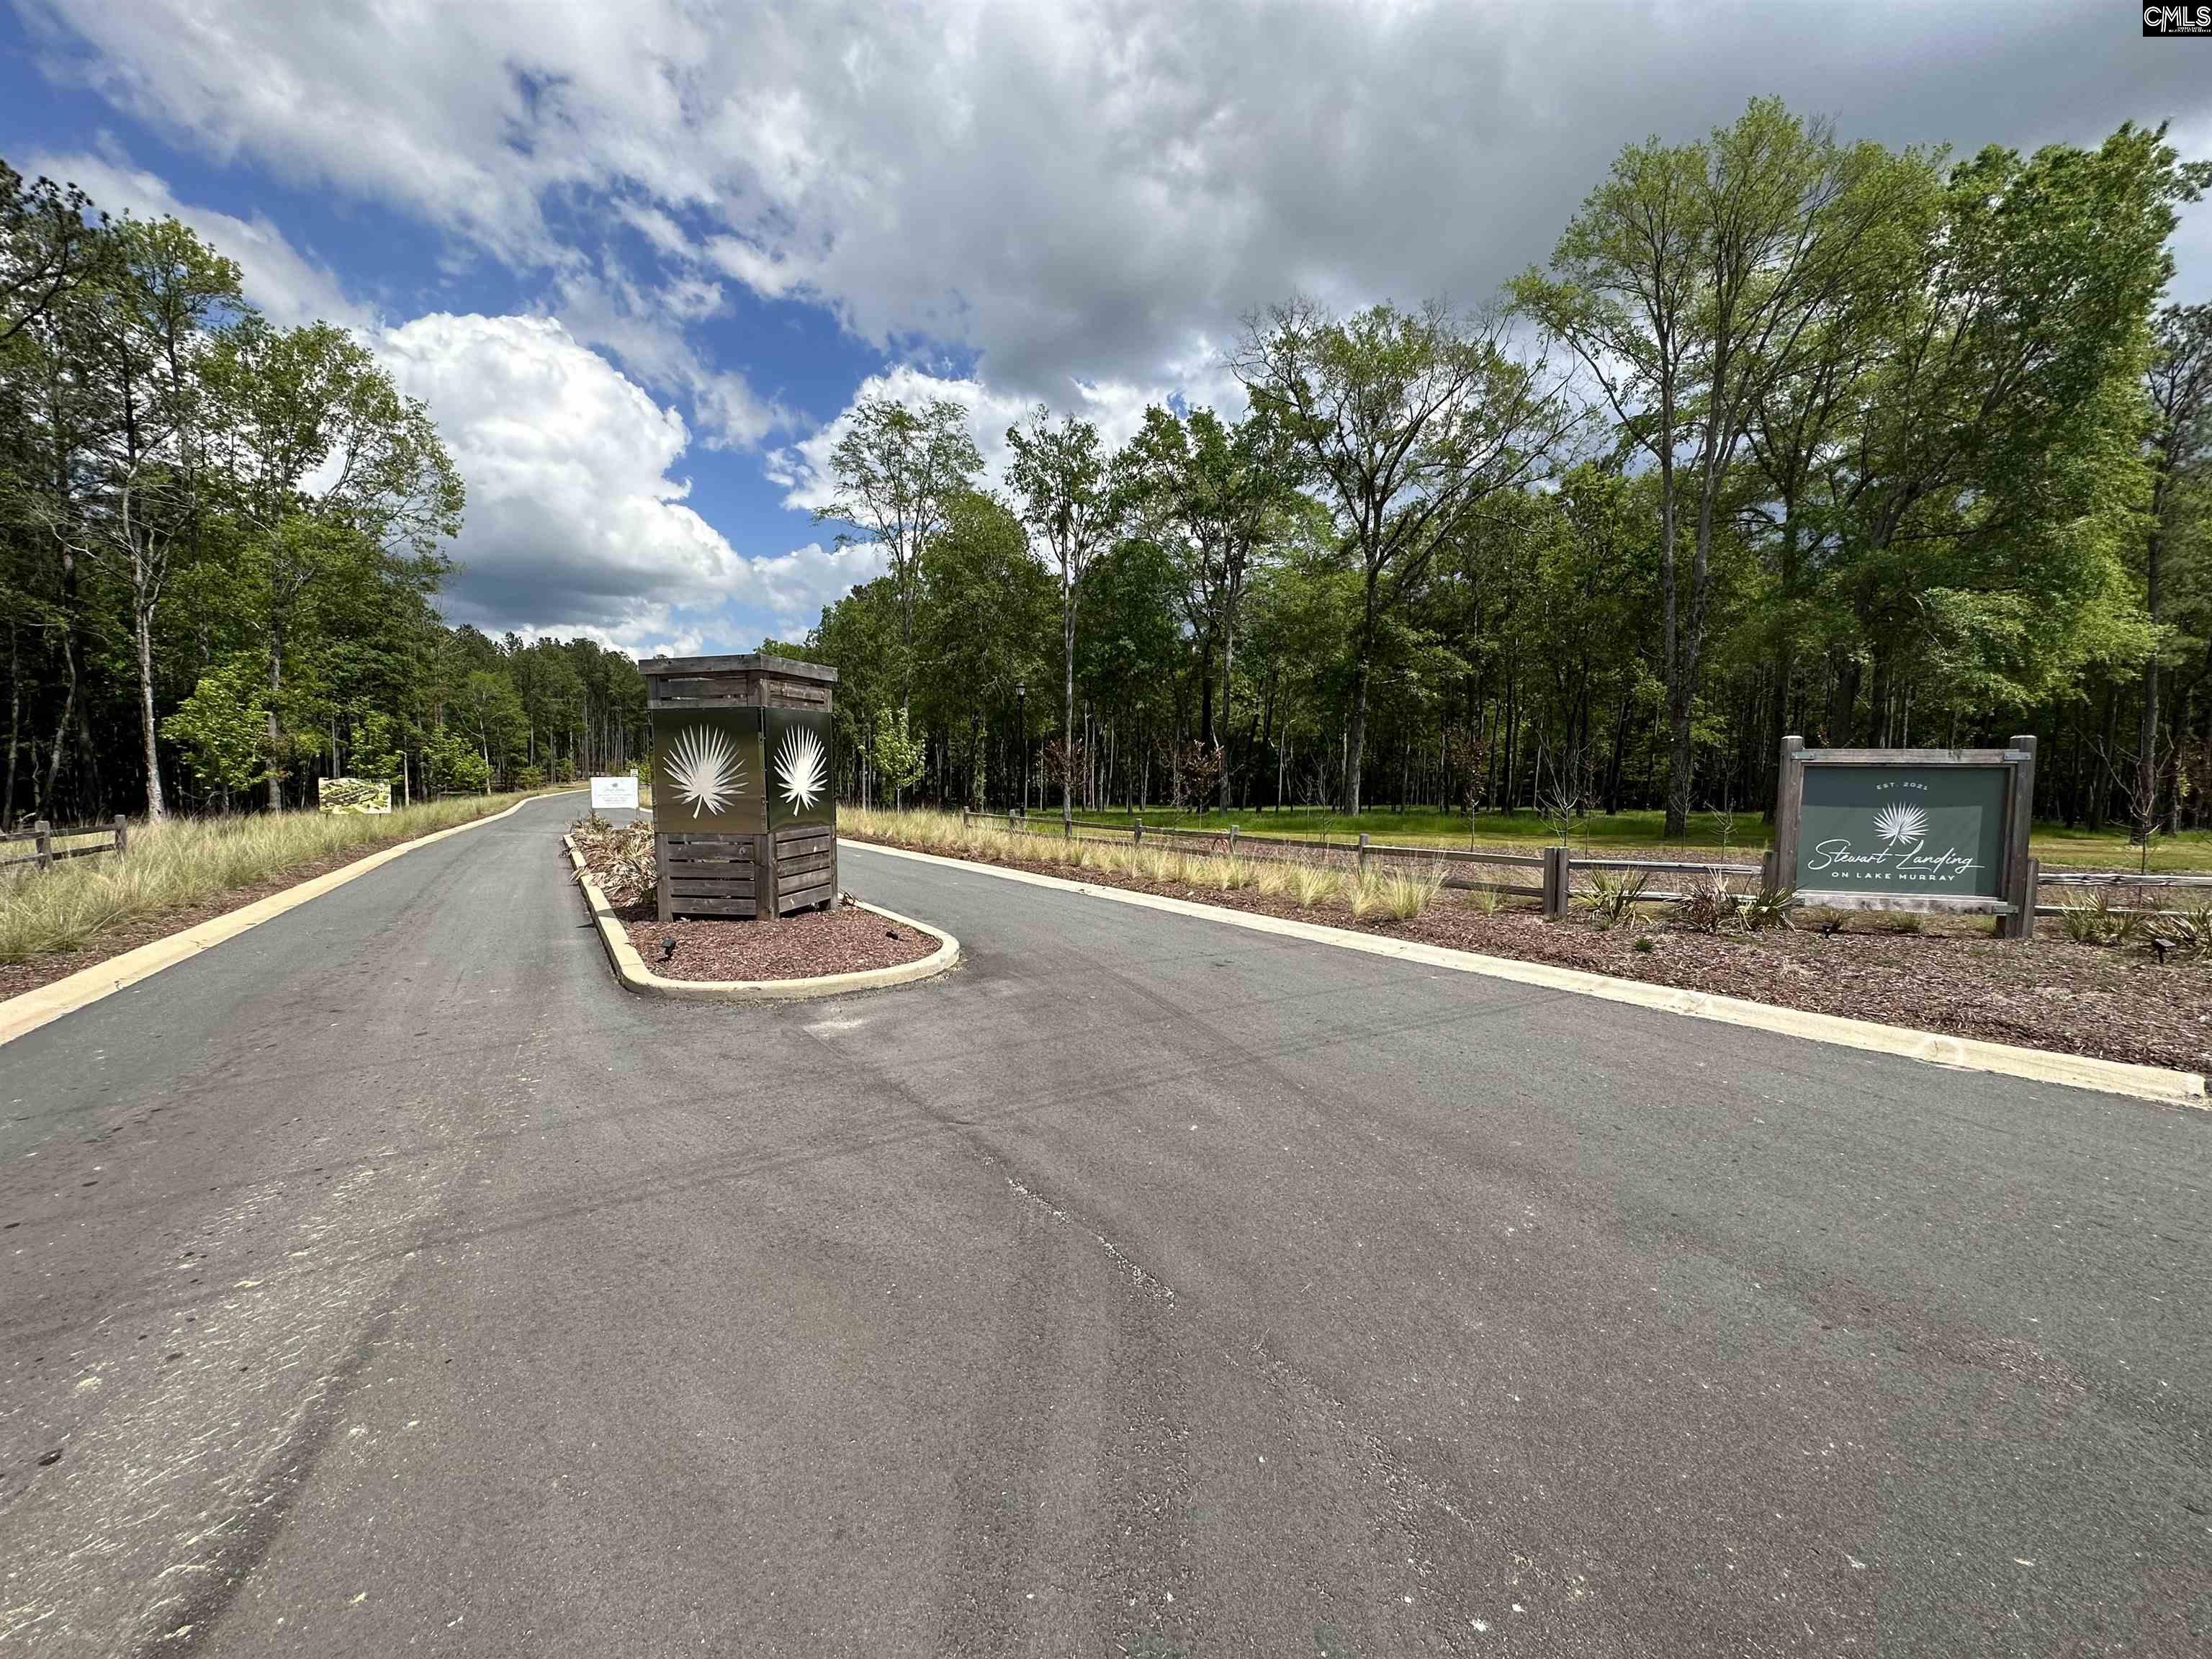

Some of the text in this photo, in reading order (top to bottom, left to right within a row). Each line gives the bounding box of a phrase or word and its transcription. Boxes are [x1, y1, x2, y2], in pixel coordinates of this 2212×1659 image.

[1903, 782, 1928, 791] 2021
[1807, 838, 1985, 874] Stewart Landing
[1898, 873, 1956, 882] MURRAY
